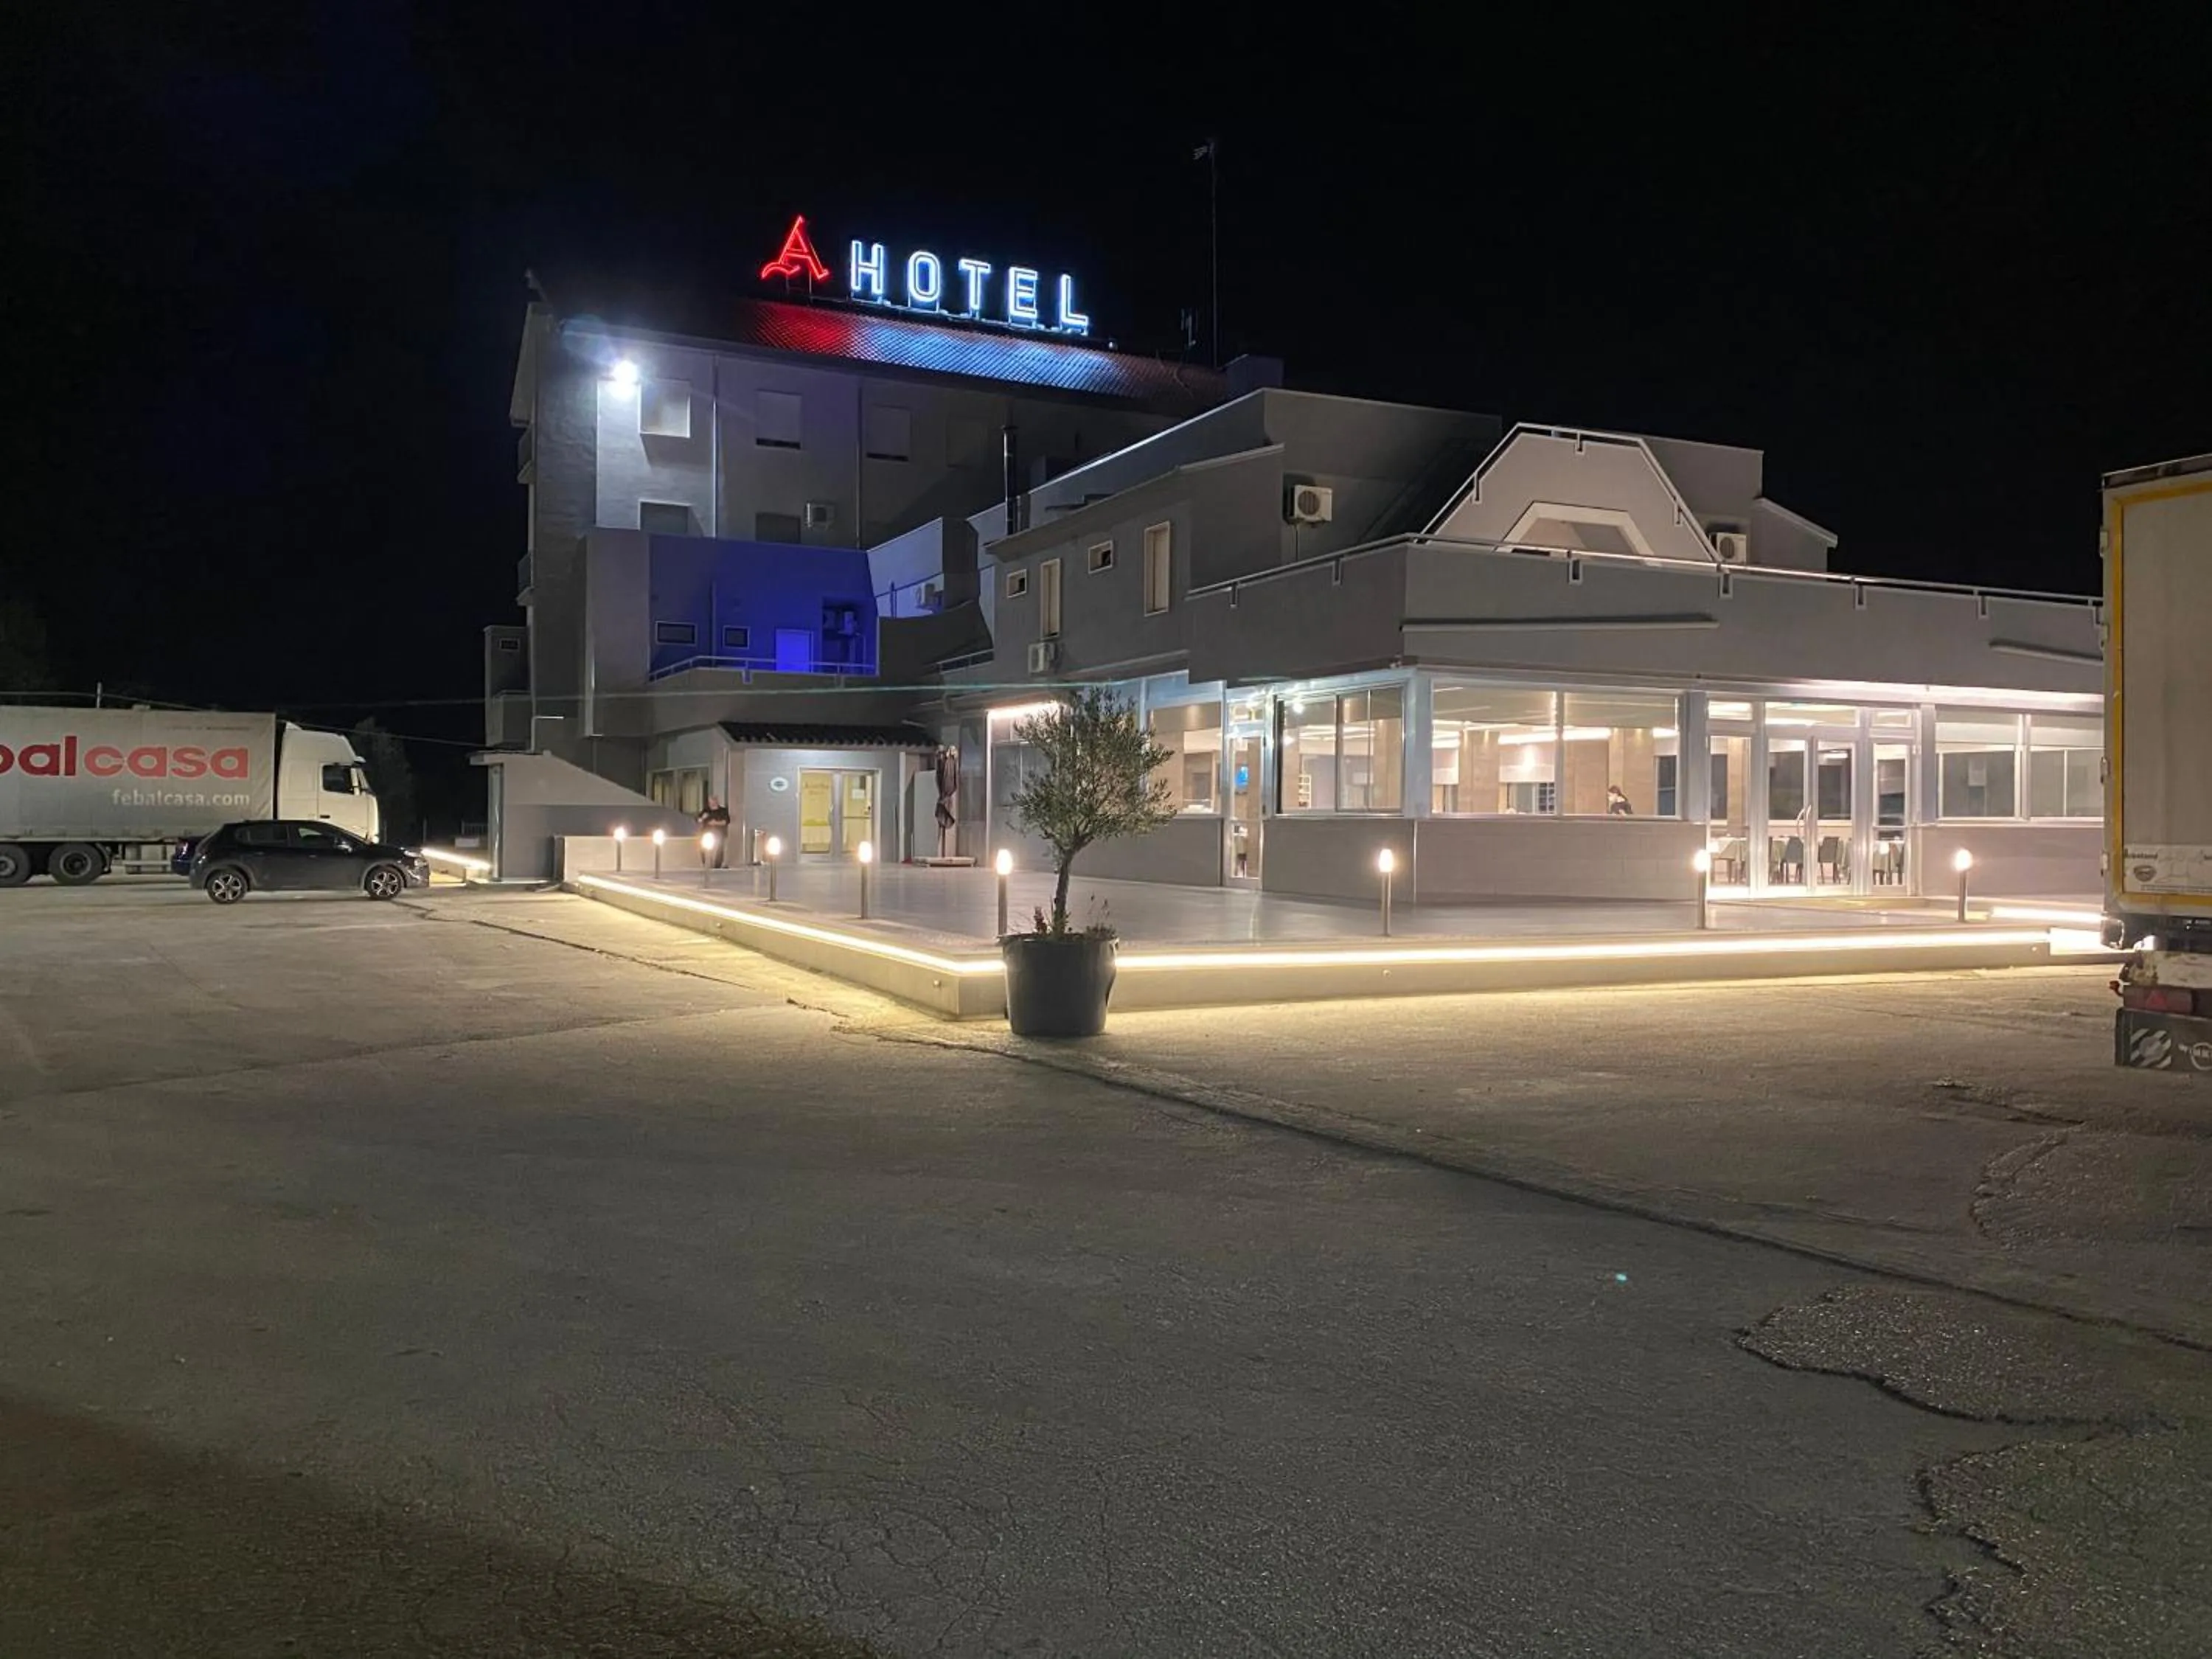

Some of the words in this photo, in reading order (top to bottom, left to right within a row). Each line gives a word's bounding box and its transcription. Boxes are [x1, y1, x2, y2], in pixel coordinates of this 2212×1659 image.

[761, 215, 830, 280] A
[850, 238, 1089, 327] HOTEL
[112, 788, 251, 807] febalcasa.com
